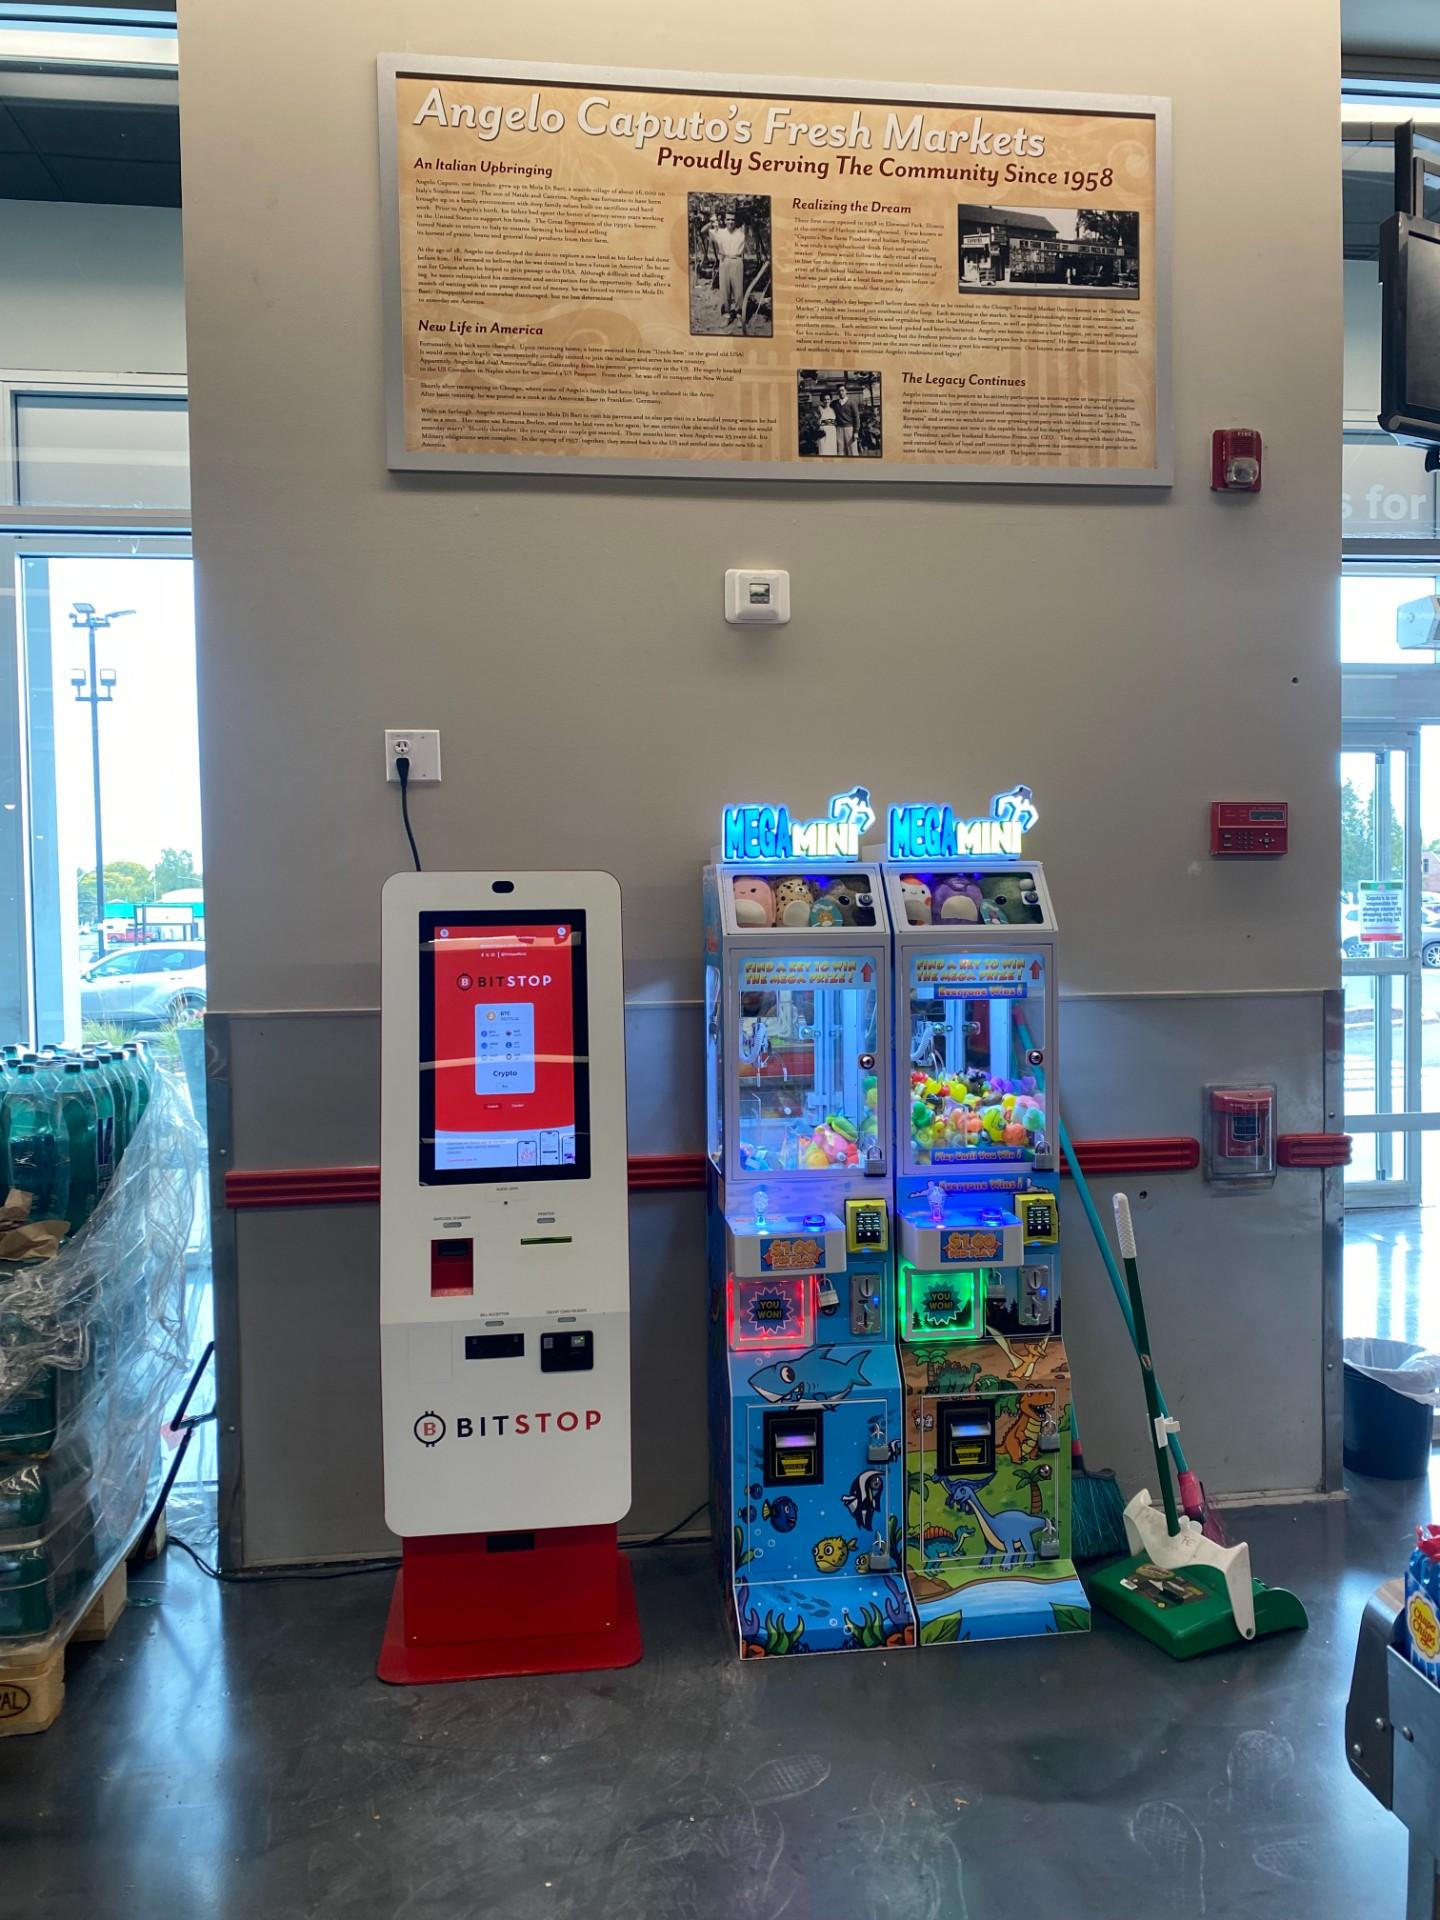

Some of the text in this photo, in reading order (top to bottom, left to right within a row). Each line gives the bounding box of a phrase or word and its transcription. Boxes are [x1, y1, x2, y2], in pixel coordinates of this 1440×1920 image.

[413, 88, 1046, 158] Angelo Caputo's Fresh Markets
[414, 158, 553, 177] An Italian Upbringing
[658, 147, 1114, 191] Proudly Serving The Community Since 1958
[792, 198, 912, 214] Realizing the Dream
[419, 319, 544, 336] New Life in America
[901, 371, 1026, 389] The Legacy Continues
[1366, 484, 1426, 520] for
[724, 807, 859, 859] MEGA MINI
[890, 806, 1022, 858] MEGA MINI
[745, 960, 857, 973] FIND A KEY TO WIN
[917, 958, 1026, 970] FIND A KEY TO WIN
[478, 975, 552, 988] BITSTOP
[746, 973, 768, 984] THE
[770, 974, 807, 984] MEGA
[917, 970, 938, 982] THE
[940, 971, 977, 982] MEGA
[938, 986, 988, 998] Everyone
[492, 1070, 518, 1078] Crypto
[934, 1151, 955, 1162] Play
[955, 1150, 978, 1161] Until
[978, 1150, 997, 1160] You
[948, 1232, 997, 1249] $1.00
[770, 1240, 818, 1256] $1.00
[968, 1248, 997, 1258] PLAY
[791, 1256, 818, 1264] PLAY
[931, 1293, 951, 1301] YOU
[760, 1301, 780, 1309] YOU
[929, 1301, 954, 1310] WON!
[757, 1310, 783, 1319] WON!
[456, 1410, 603, 1438] BITSTOP
[0, 1691, 23, 1711] AL
